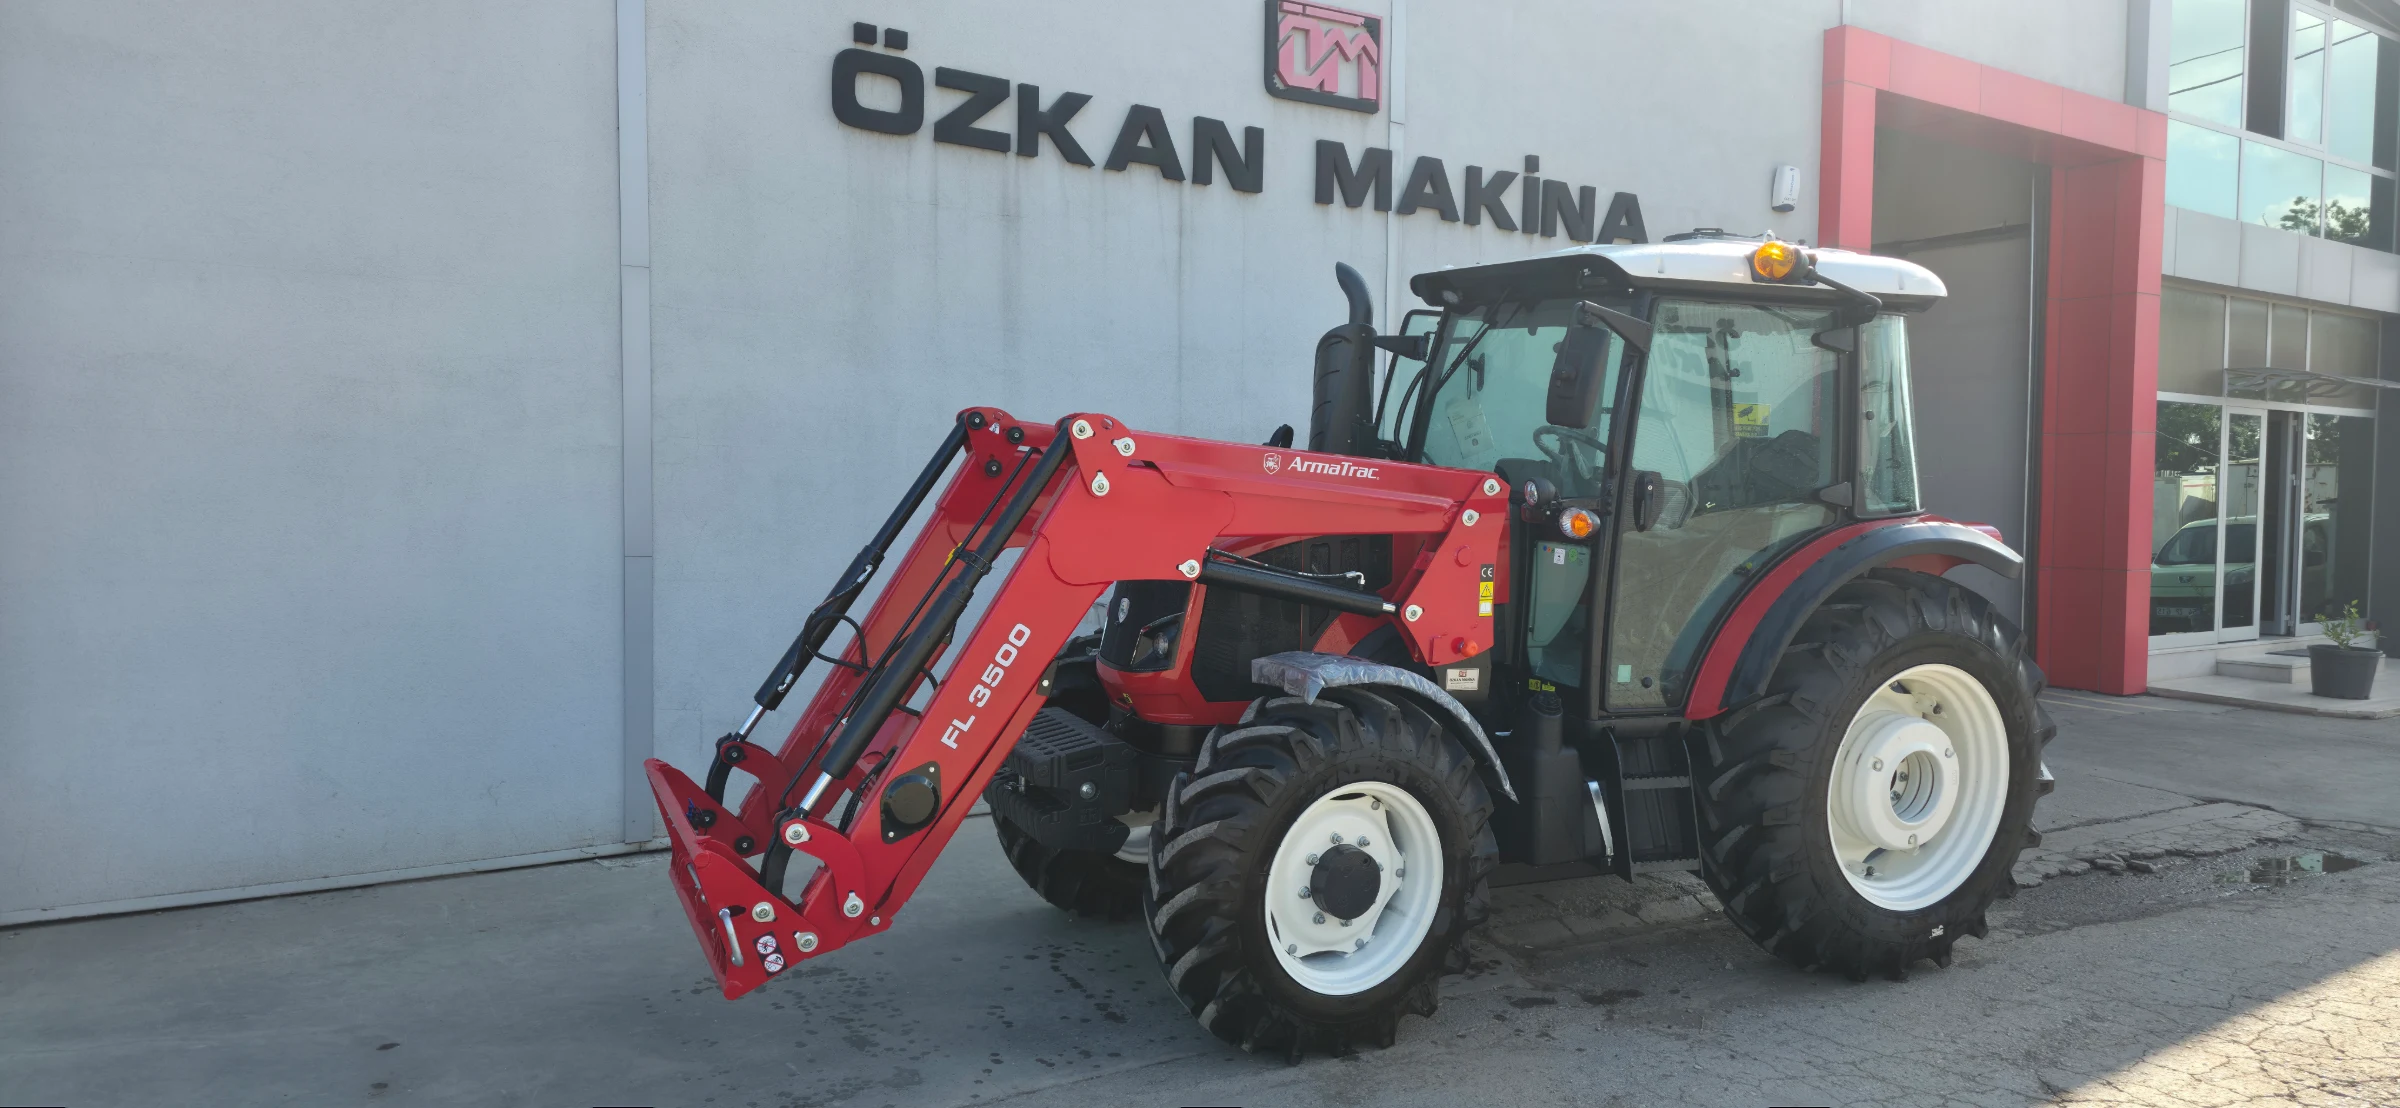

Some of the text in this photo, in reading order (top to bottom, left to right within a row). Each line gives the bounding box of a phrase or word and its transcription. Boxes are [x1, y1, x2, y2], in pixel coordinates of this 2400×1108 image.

[831, 21, 1650, 245] ÖZKAN MAKİNA
[1287, 456, 1379, 480] ArmaTrac
[940, 623, 1032, 750] FL 3500
